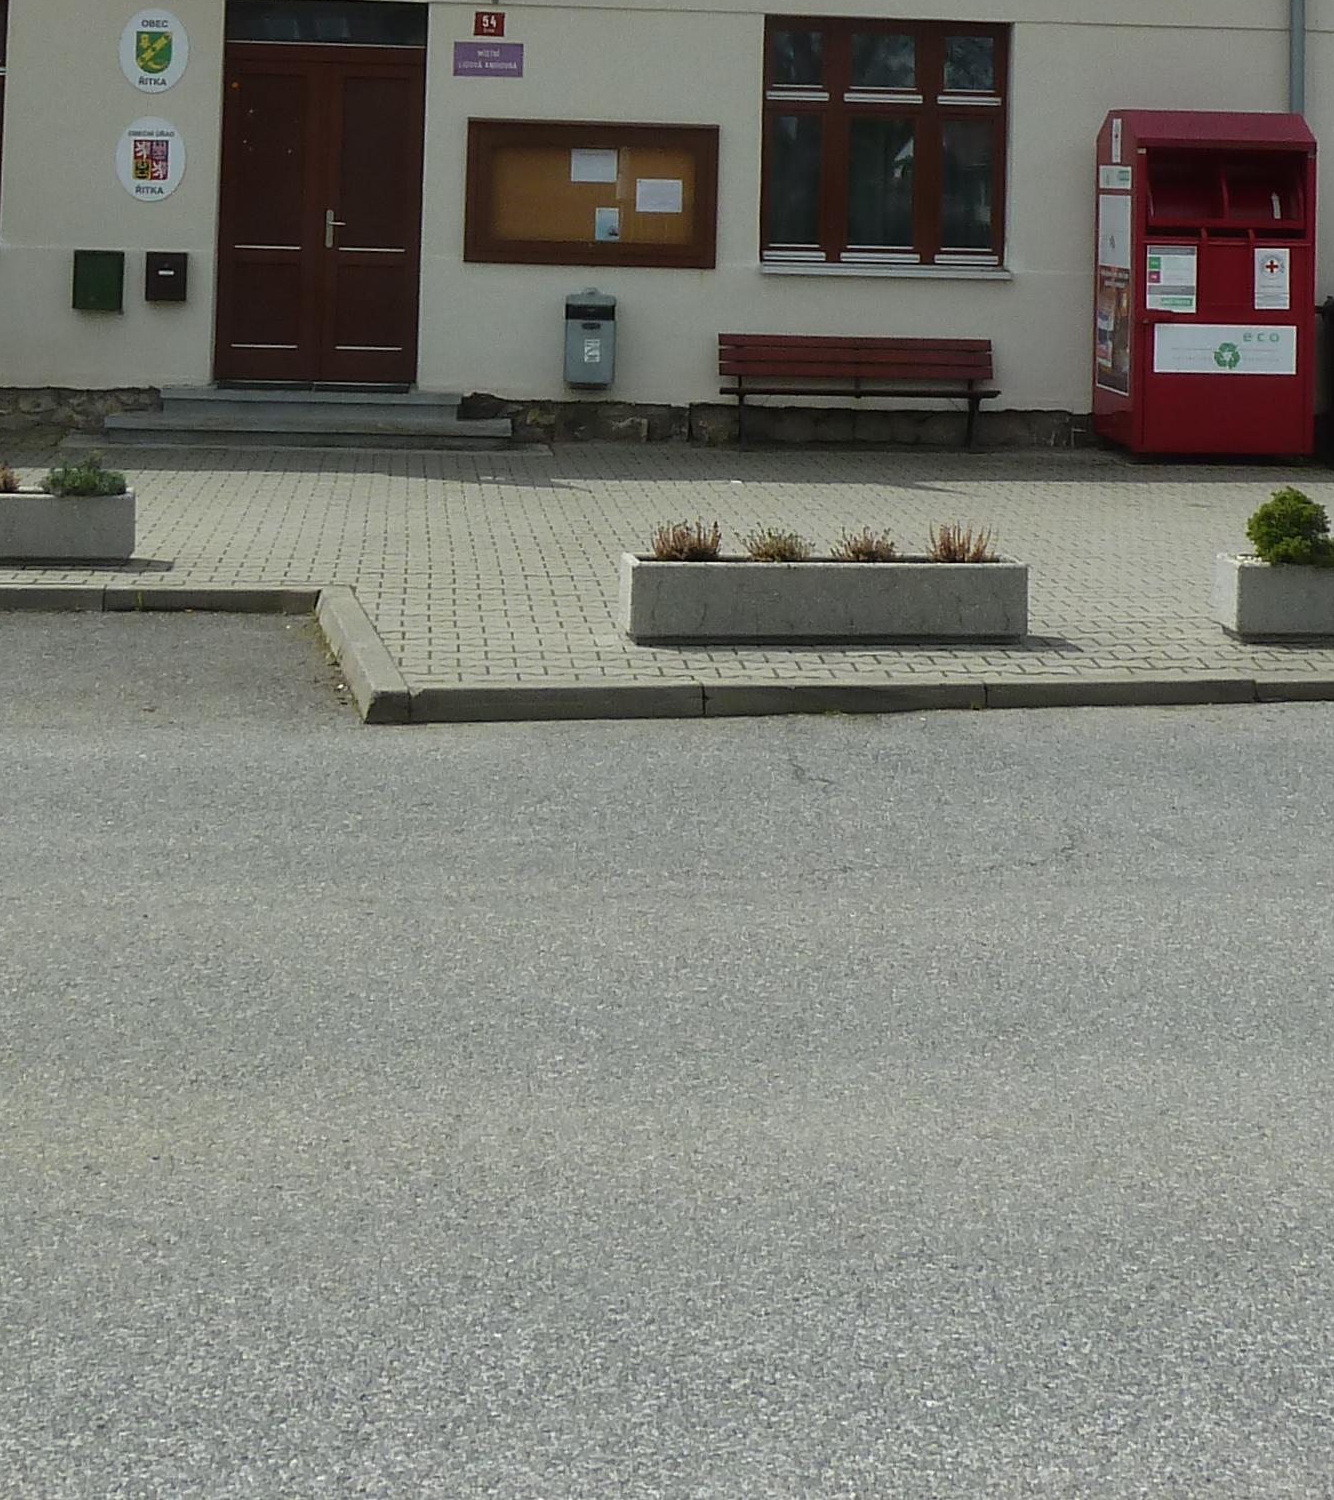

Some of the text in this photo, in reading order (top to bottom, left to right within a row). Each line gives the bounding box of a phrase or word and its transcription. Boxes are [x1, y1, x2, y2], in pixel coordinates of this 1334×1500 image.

[141, 20, 169, 28] OBEC
[482, 15, 497, 28] 54
[139, 76, 167, 86] ŘITKA
[135, 185, 164, 194] ŘITKA
